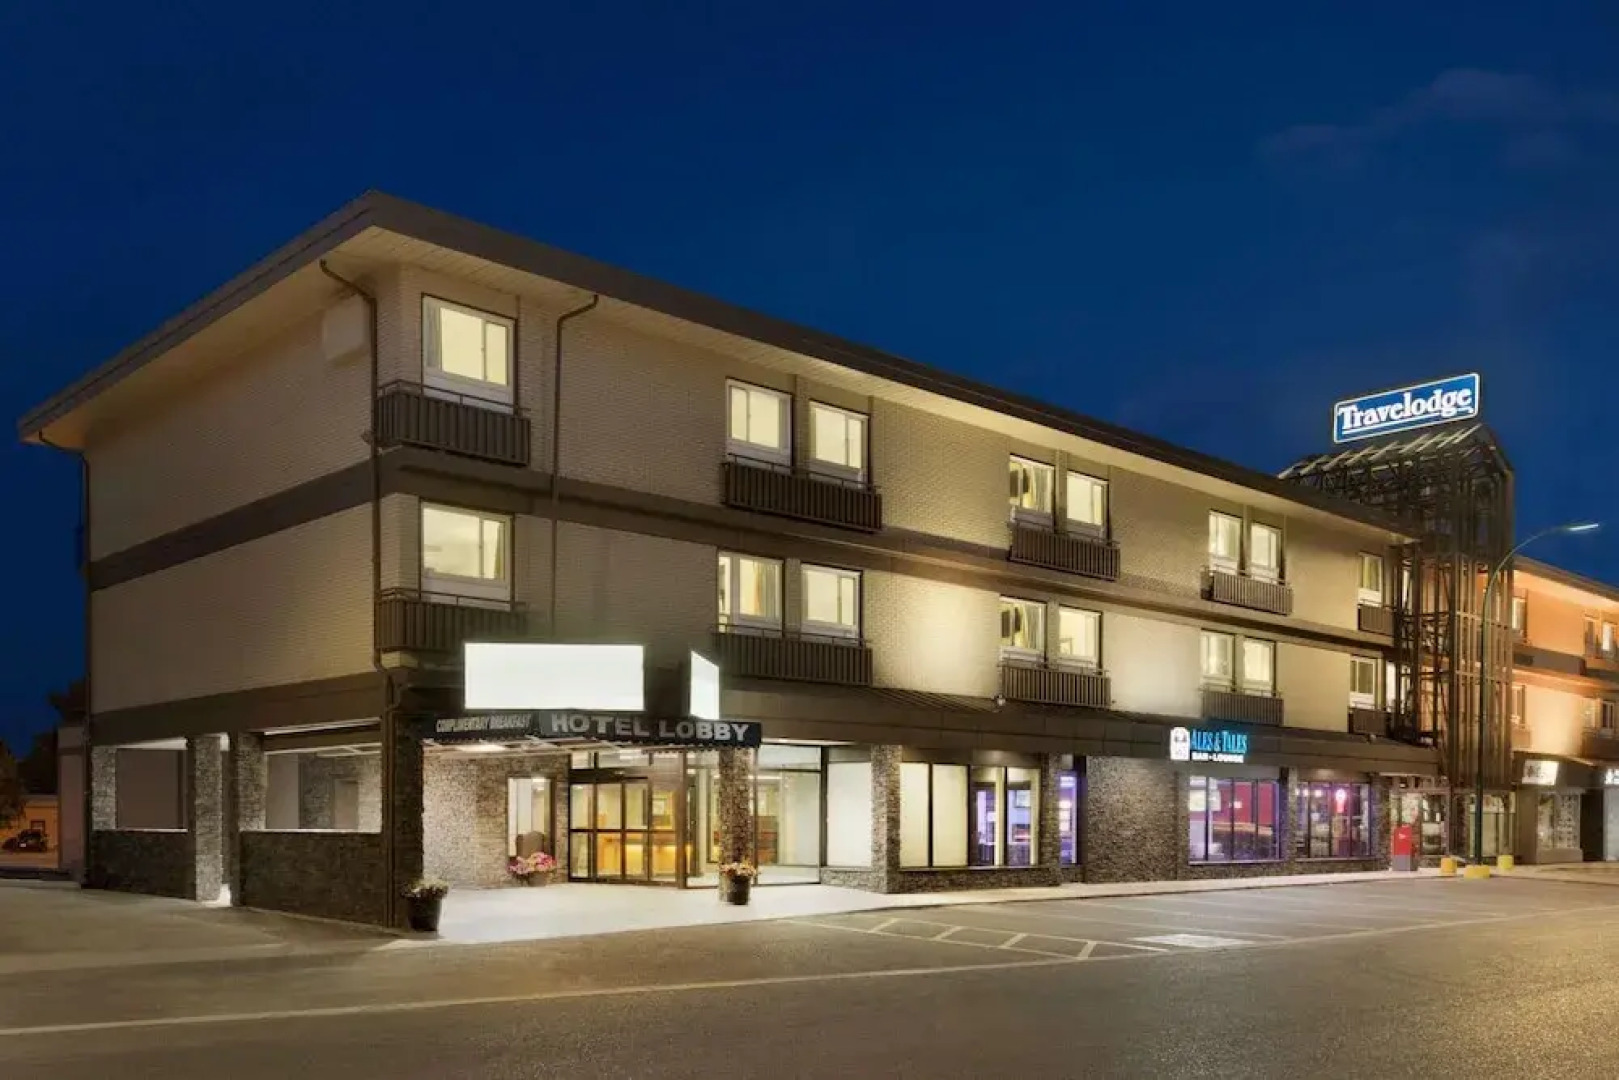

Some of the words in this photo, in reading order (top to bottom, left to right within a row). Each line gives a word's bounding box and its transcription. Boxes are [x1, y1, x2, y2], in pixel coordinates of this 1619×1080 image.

[1337, 387, 1473, 430] Travelodge
[551, 713, 650, 736] HOTEL
[658, 718, 749, 741] LOBBY
[1191, 729, 1213, 751] ALES
[1214, 731, 1221, 751] &
